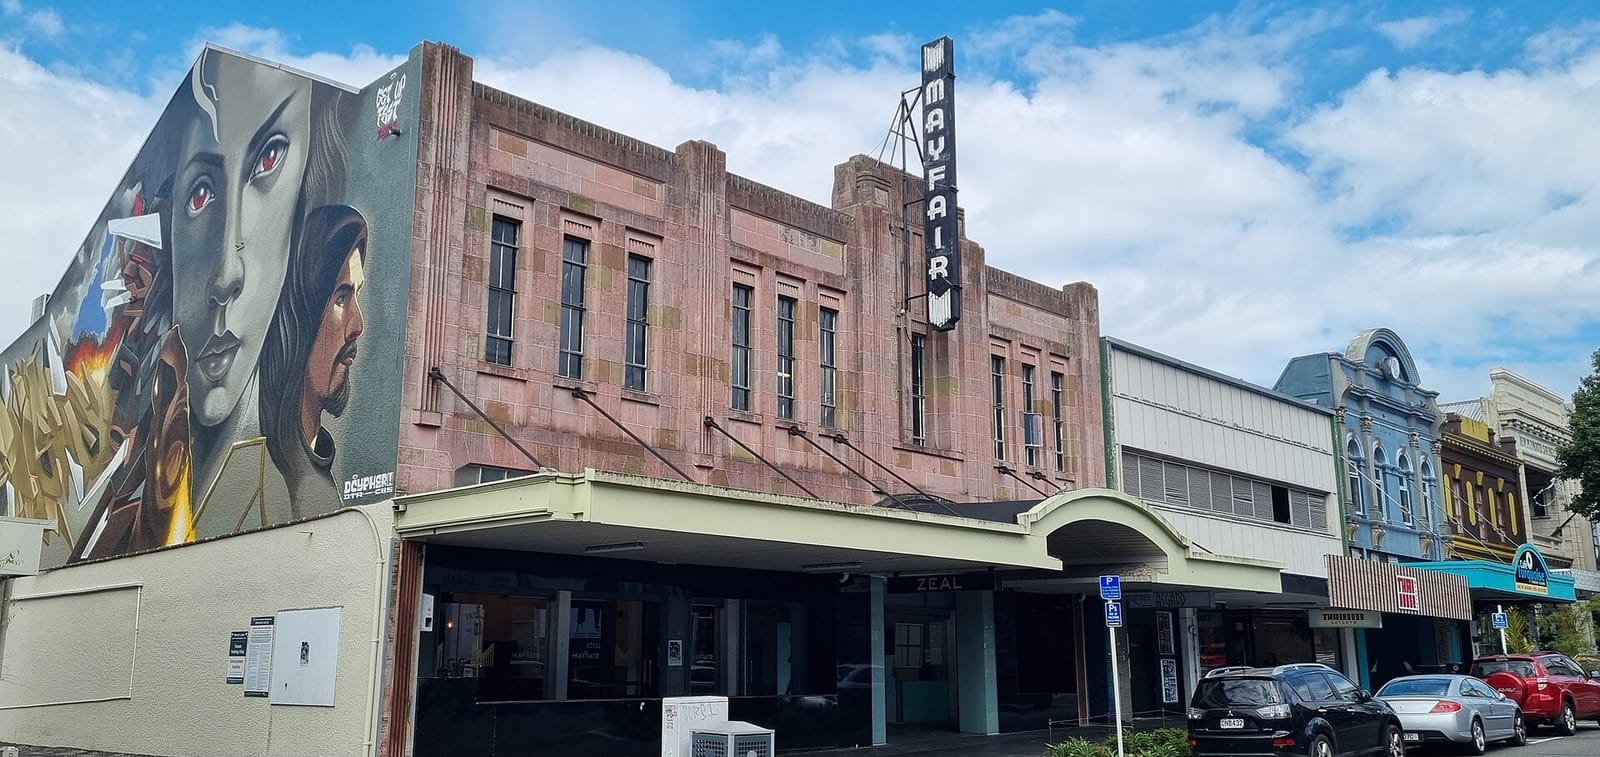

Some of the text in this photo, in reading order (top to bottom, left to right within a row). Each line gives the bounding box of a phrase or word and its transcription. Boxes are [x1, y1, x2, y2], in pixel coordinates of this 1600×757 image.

[925, 79, 949, 281] MAYFAIR
[917, 577, 962, 591] ZEAL
[1106, 577, 1113, 586] P
